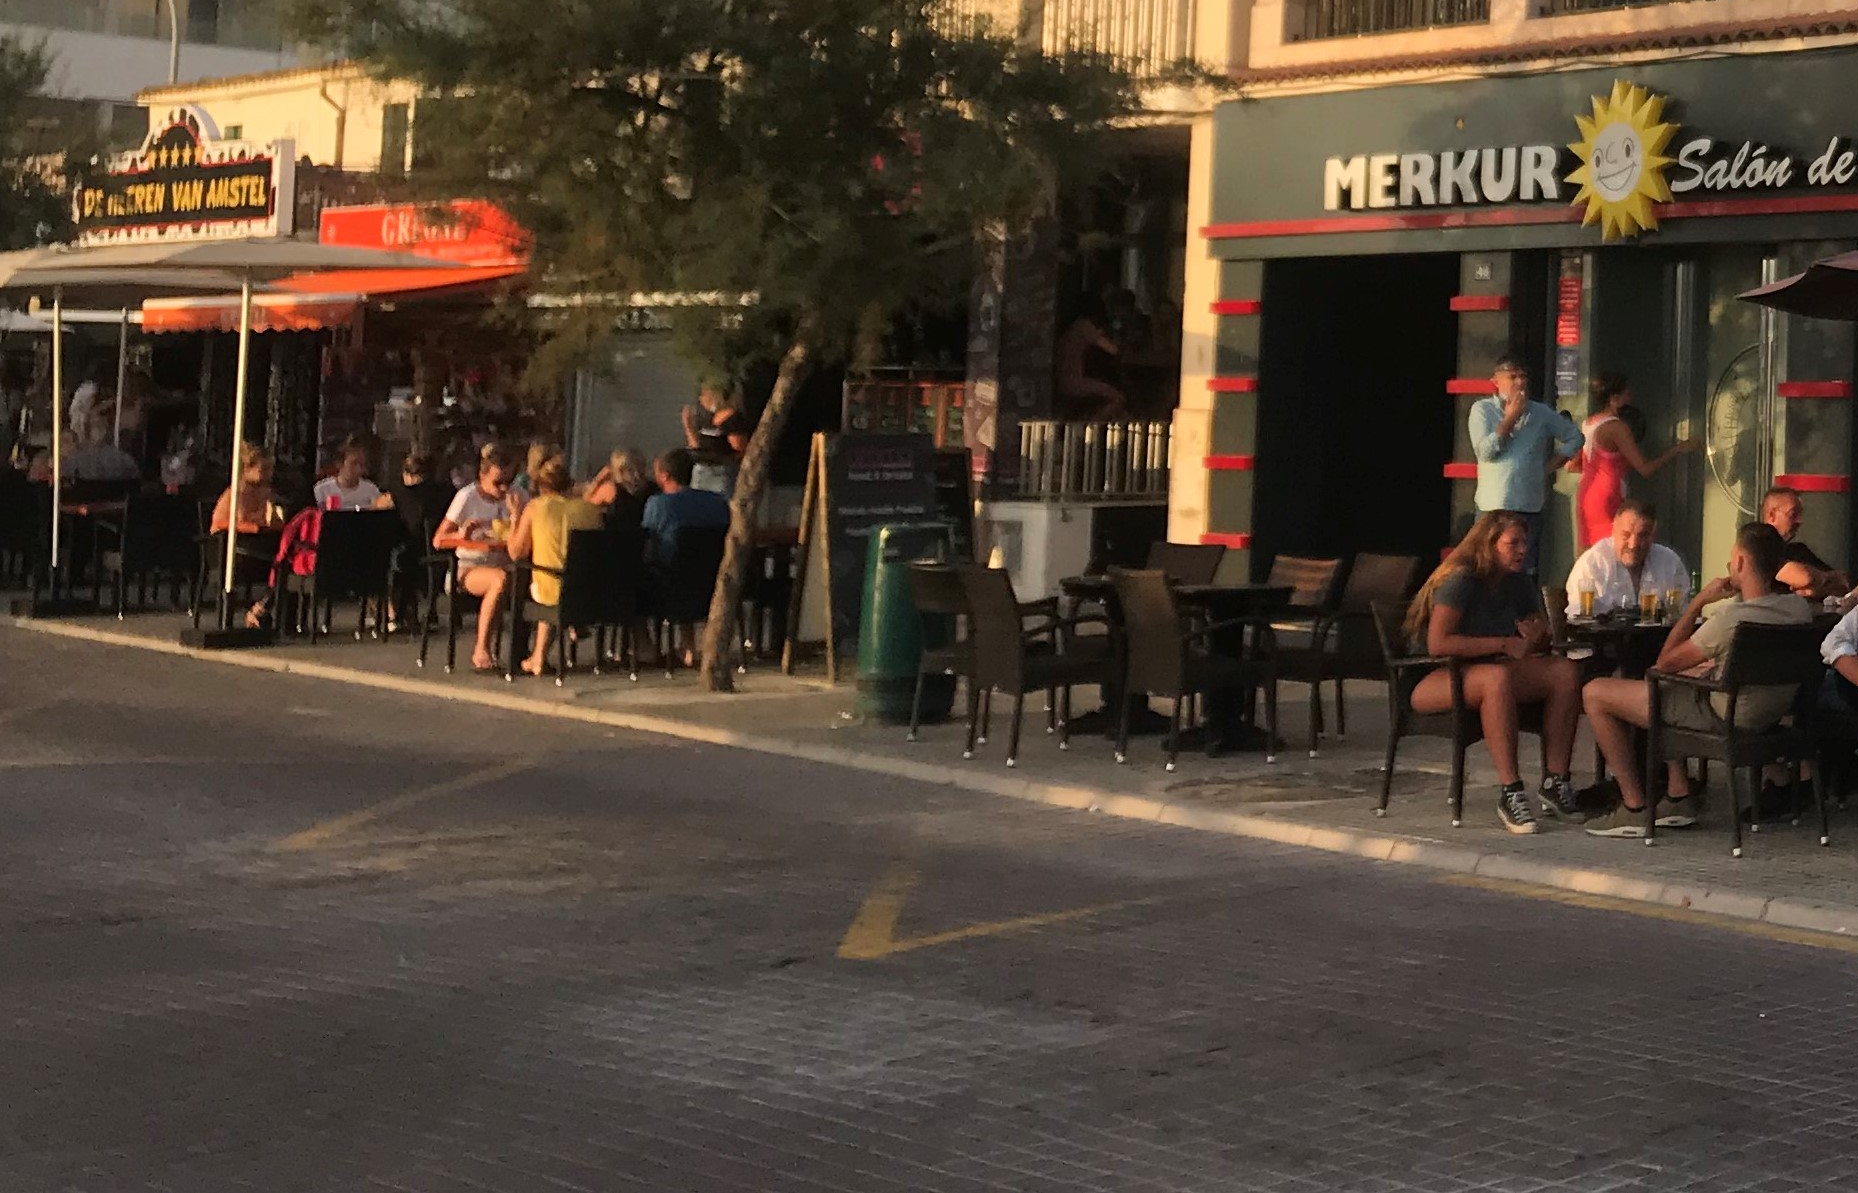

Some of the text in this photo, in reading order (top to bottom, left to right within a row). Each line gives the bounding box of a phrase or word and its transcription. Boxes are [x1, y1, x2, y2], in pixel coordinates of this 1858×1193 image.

[171, 179, 203, 212] VAN
[206, 174, 267, 209] AMSTEL
[1324, 145, 1558, 210] MERKUR
[1671, 138, 1792, 192] Salón
[1807, 136, 1855, 185] de
